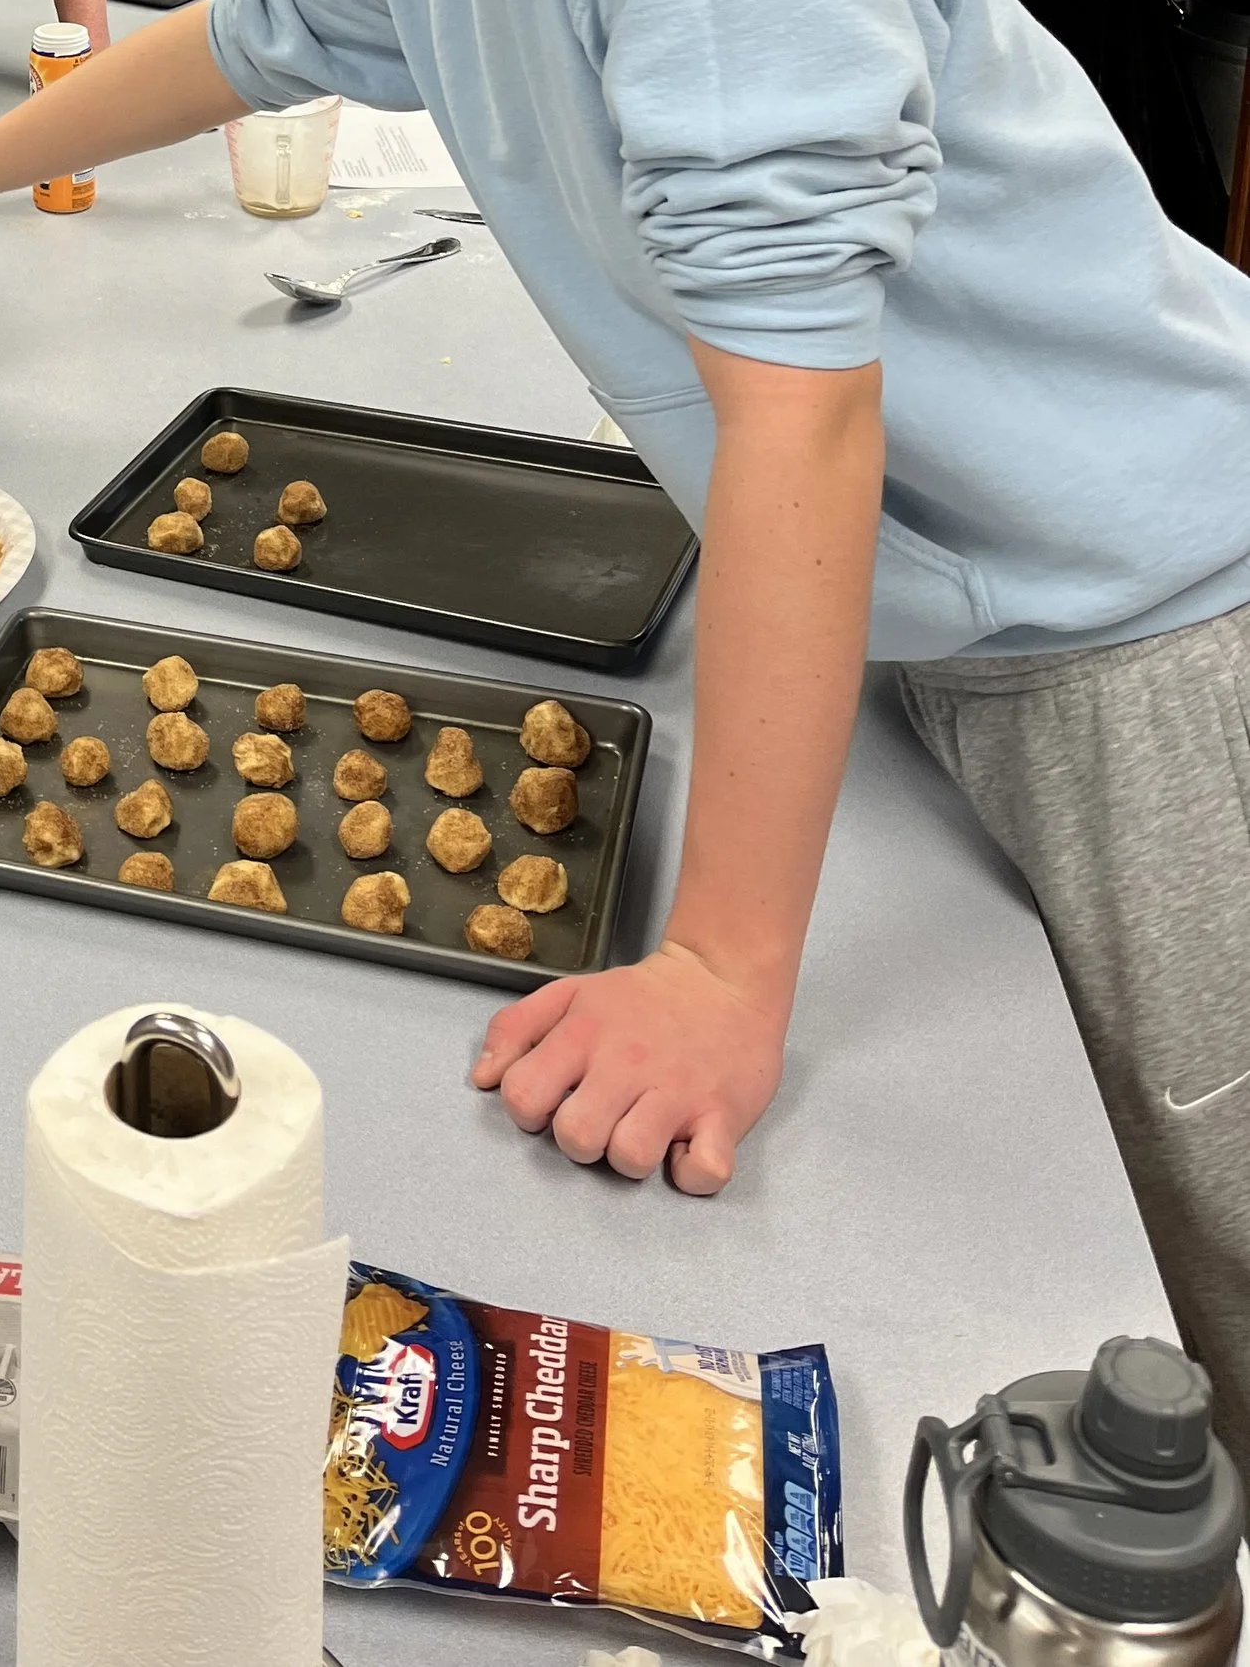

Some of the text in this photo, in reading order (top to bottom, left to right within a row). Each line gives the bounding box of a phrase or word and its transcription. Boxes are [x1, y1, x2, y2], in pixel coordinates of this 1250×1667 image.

[394, 1373, 423, 1425] Kraf
[430, 1340, 465, 1468] Natural Cheese
[488, 1352, 508, 1458] FINELY SHREDDED
[573, 1361, 598, 1477] SHREDDED CHEDDAR CHEESE
[518, 1426, 570, 1532] Sharp
[788, 1443, 802, 1457] NET
[11, 1494, 16, 1503] 1
[454, 1521, 472, 1567] YEARS of
[465, 1511, 500, 1576] 100
